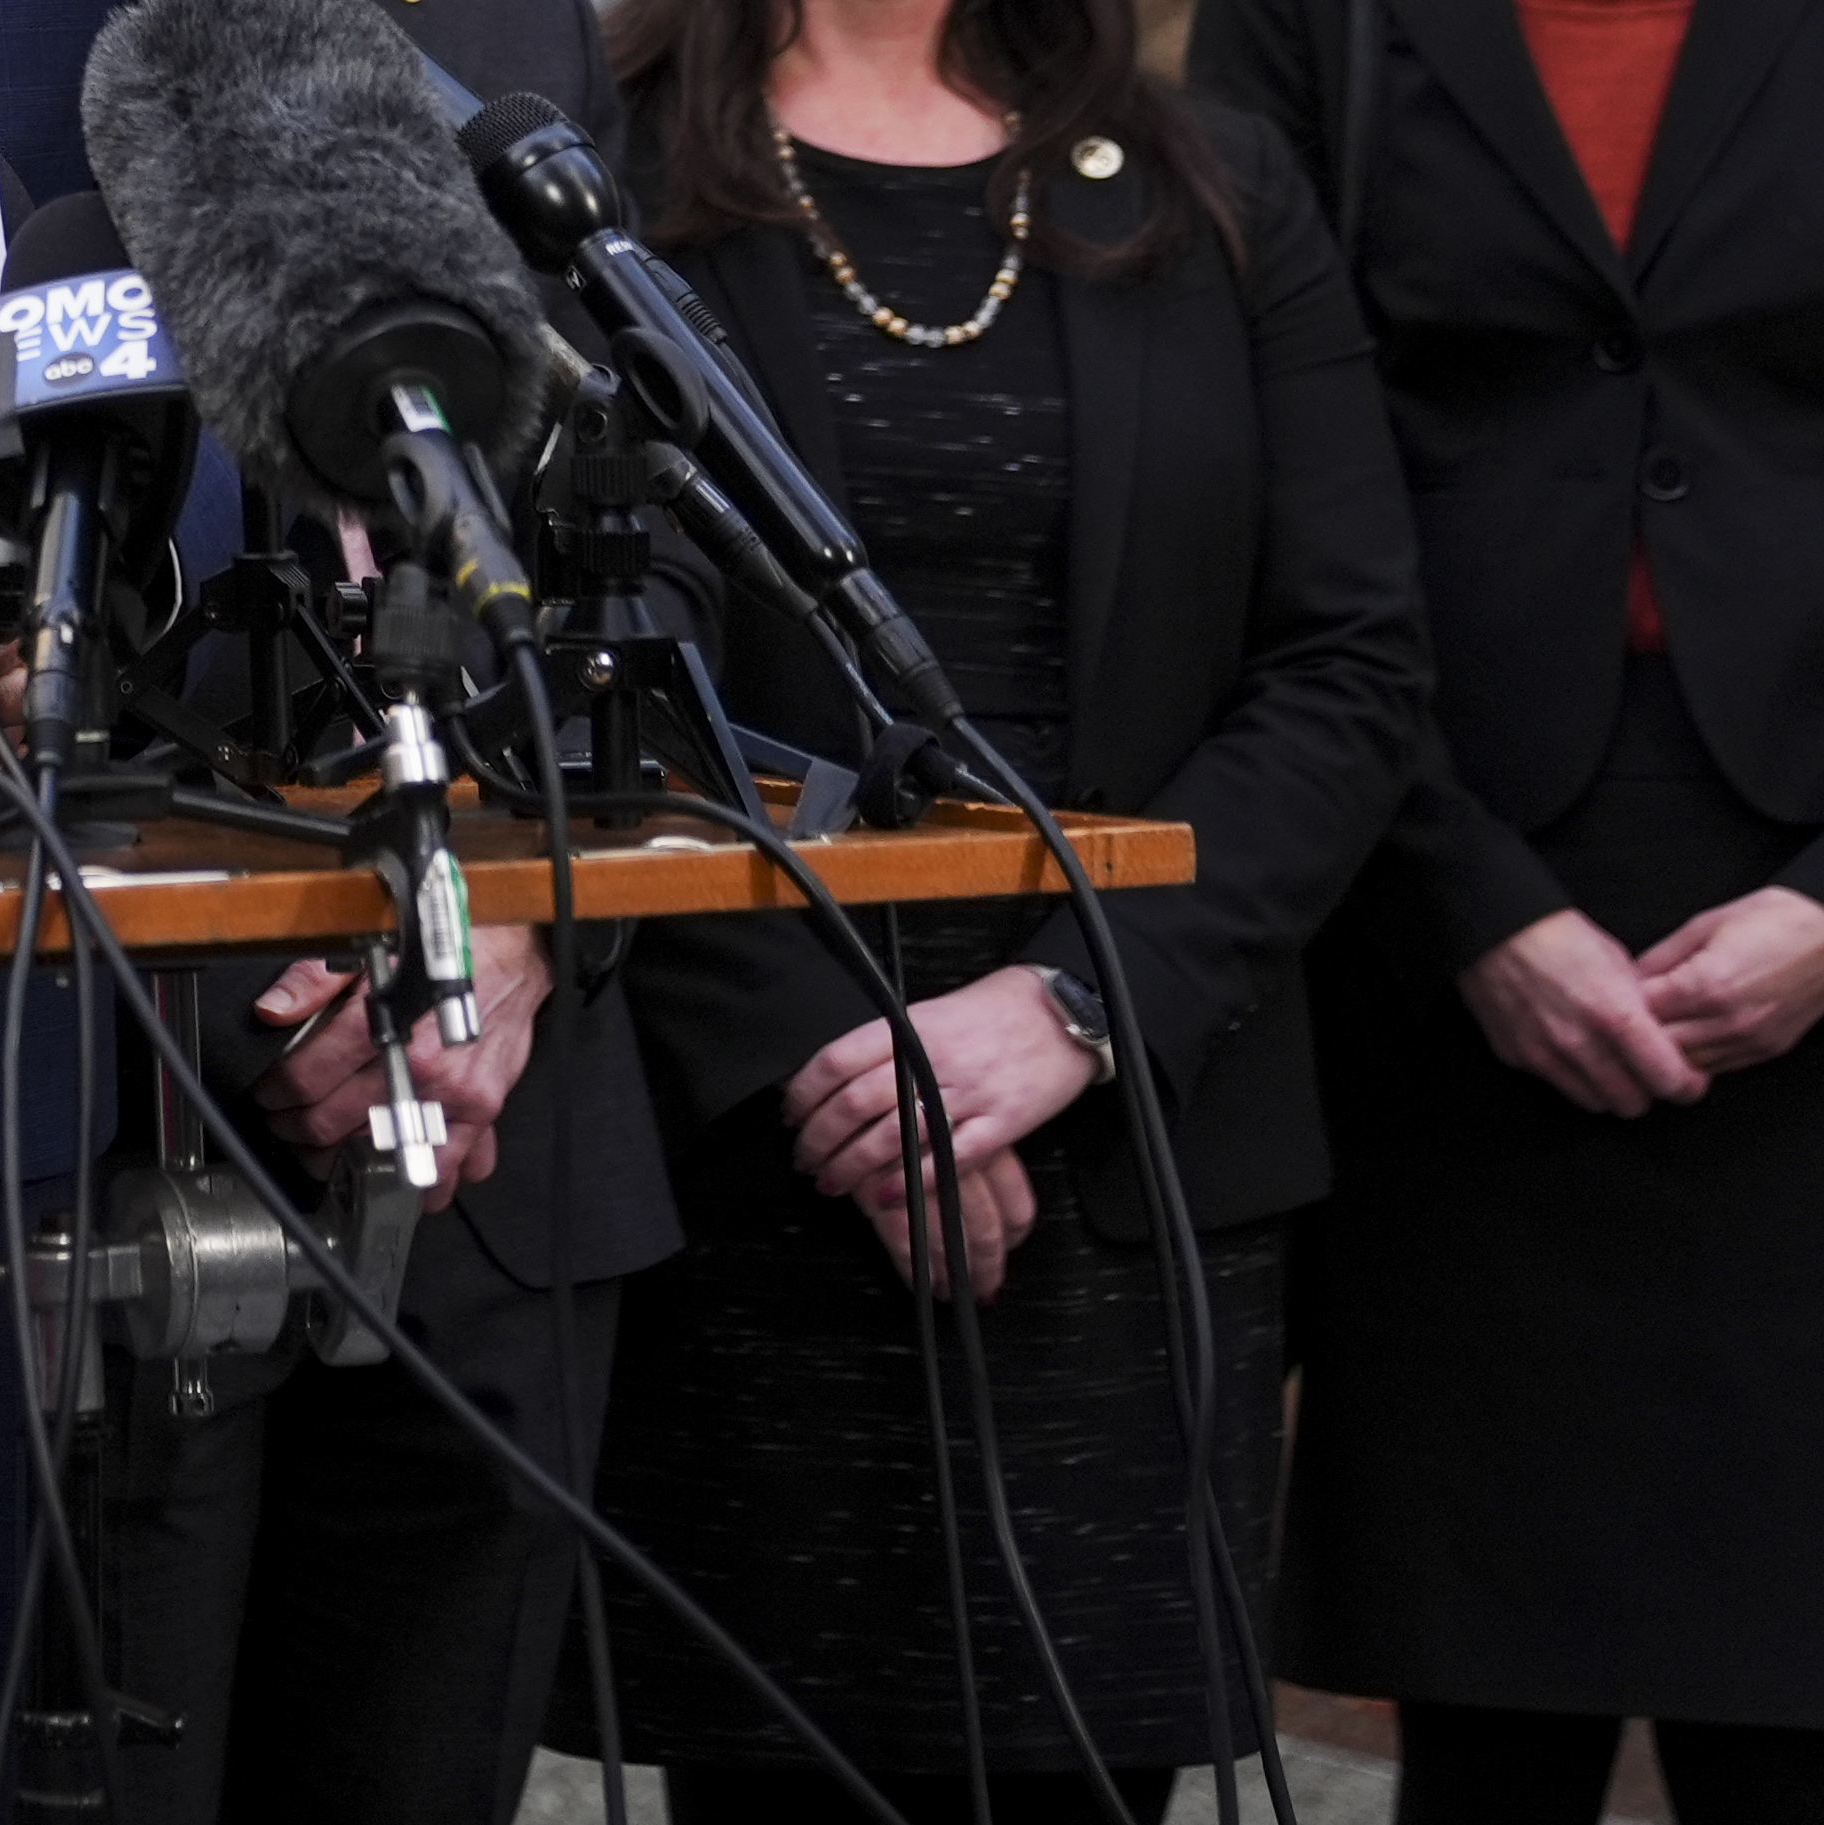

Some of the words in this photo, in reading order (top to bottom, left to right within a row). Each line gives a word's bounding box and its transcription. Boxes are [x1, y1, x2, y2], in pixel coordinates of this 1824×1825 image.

[14, 308, 158, 362] EWS
[44, 357, 94, 381] abc
[100, 339, 157, 380] 4
